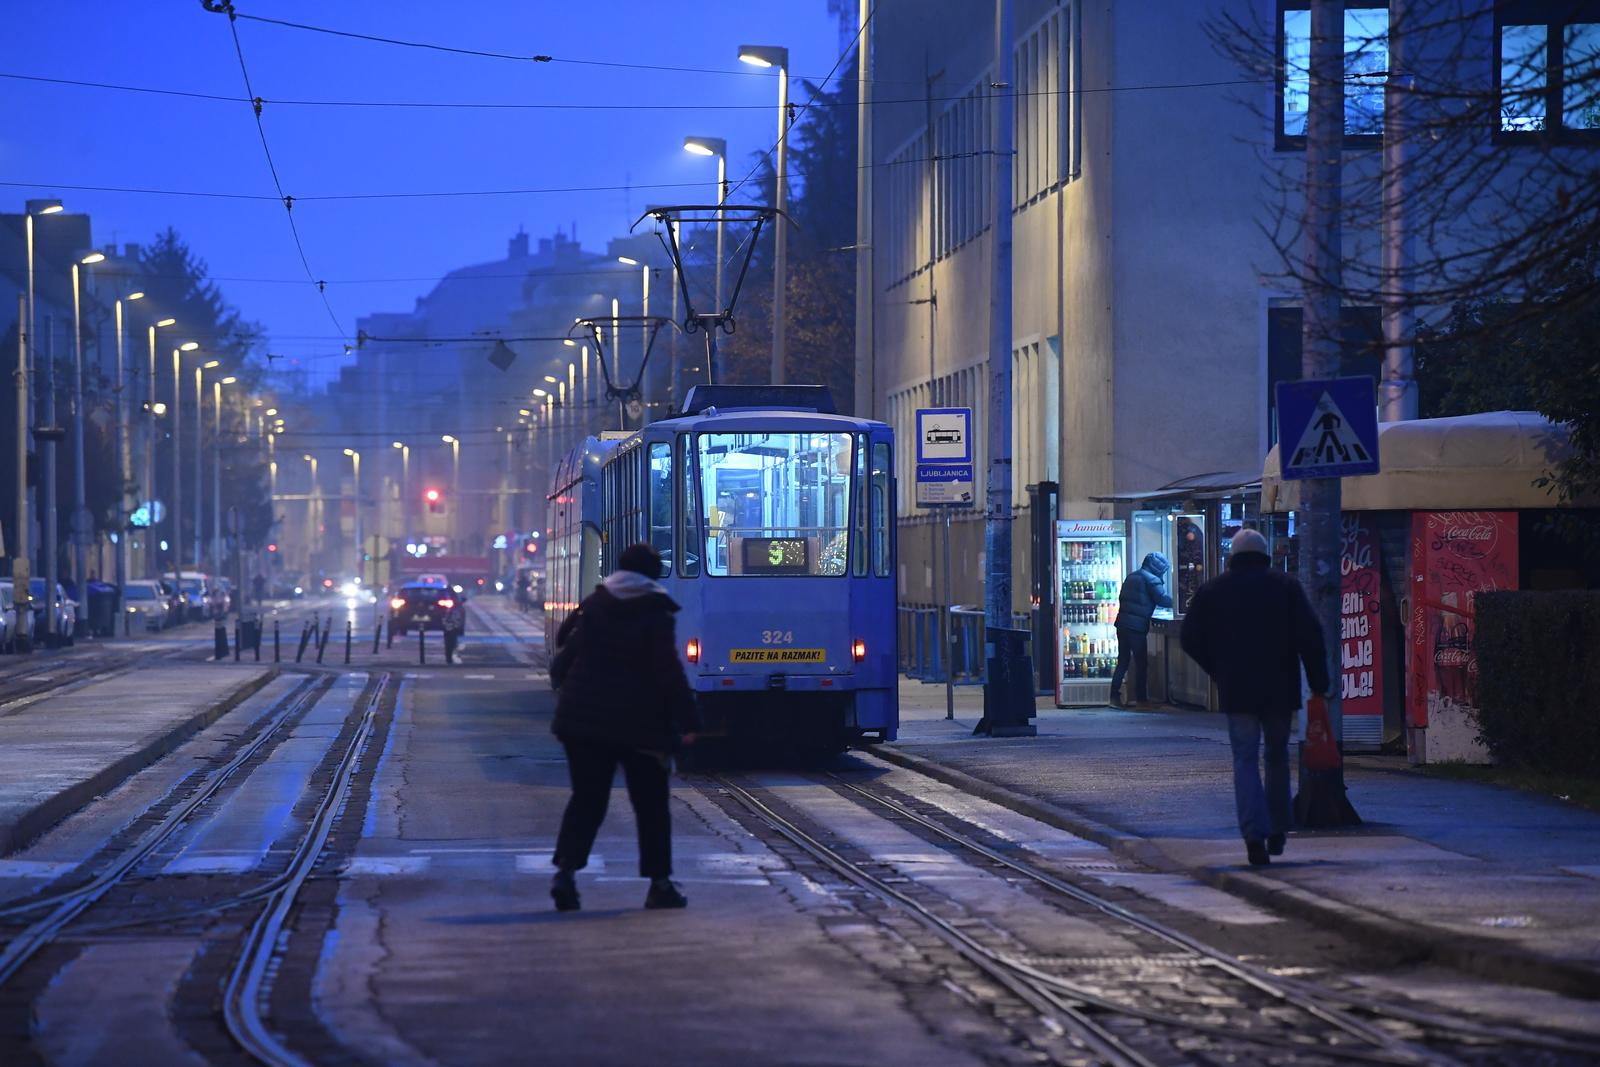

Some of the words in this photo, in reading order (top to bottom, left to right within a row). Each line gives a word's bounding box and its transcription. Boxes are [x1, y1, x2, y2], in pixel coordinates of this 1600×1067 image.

[1067, 523, 1115, 533] Jamnica
[1342, 592, 1364, 615] eni
[1341, 614, 1368, 640] ema
[762, 630, 793, 644] 324
[735, 651, 765, 660] PAZITE
[767, 651, 778, 660] NA
[781, 651, 821, 660] RAZMAK!
